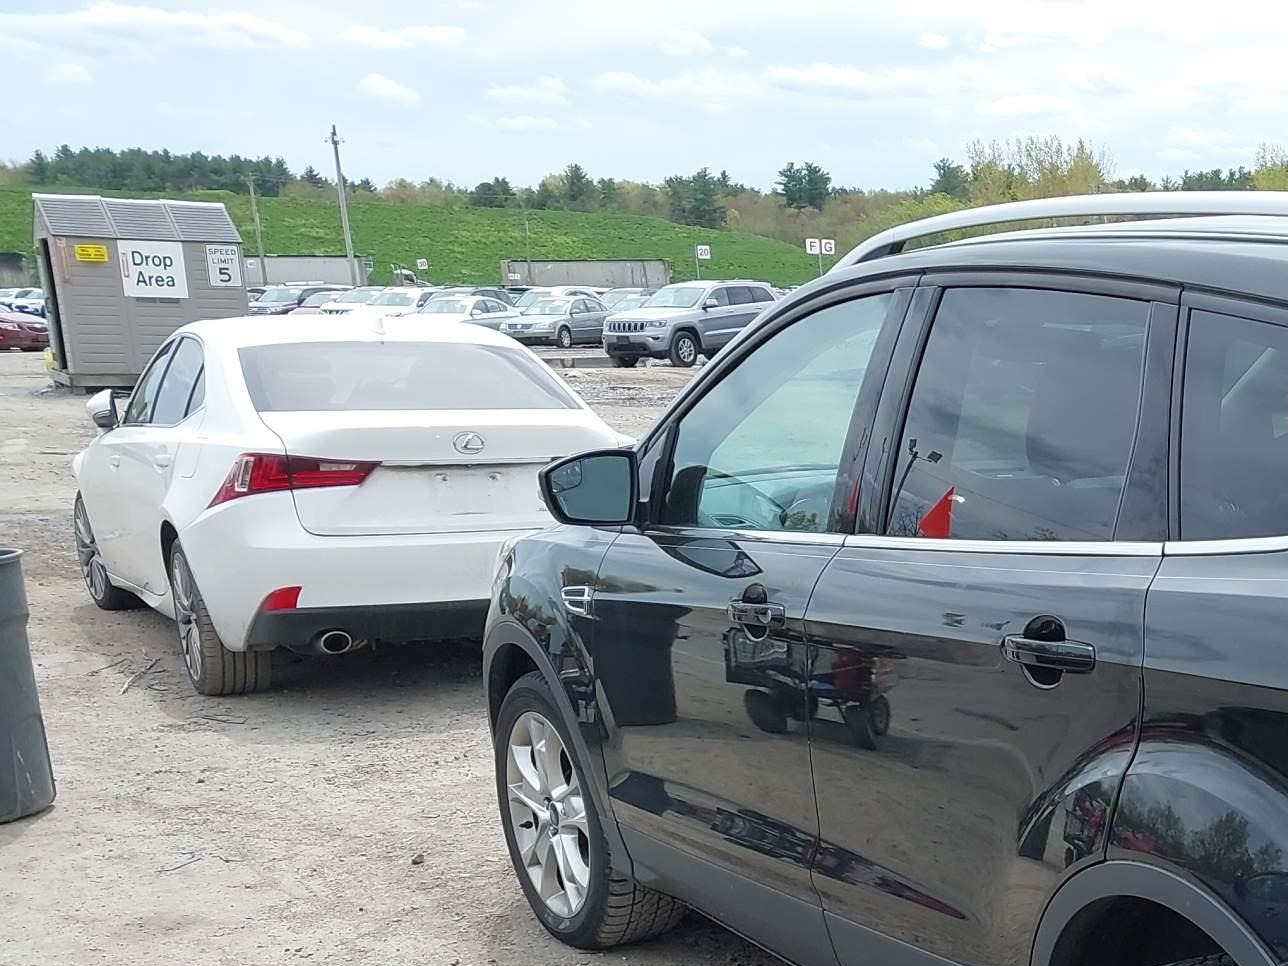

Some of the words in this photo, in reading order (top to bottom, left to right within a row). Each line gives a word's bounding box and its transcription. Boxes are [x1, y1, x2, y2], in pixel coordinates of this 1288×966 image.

[810, 240, 818, 251] F
[824, 242, 833, 252] G
[208, 248, 237, 256] SPEED
[699, 248, 709, 256] 20
[131, 250, 174, 270] Drop
[136, 271, 176, 288] Area
[219, 267, 232, 283] 5
